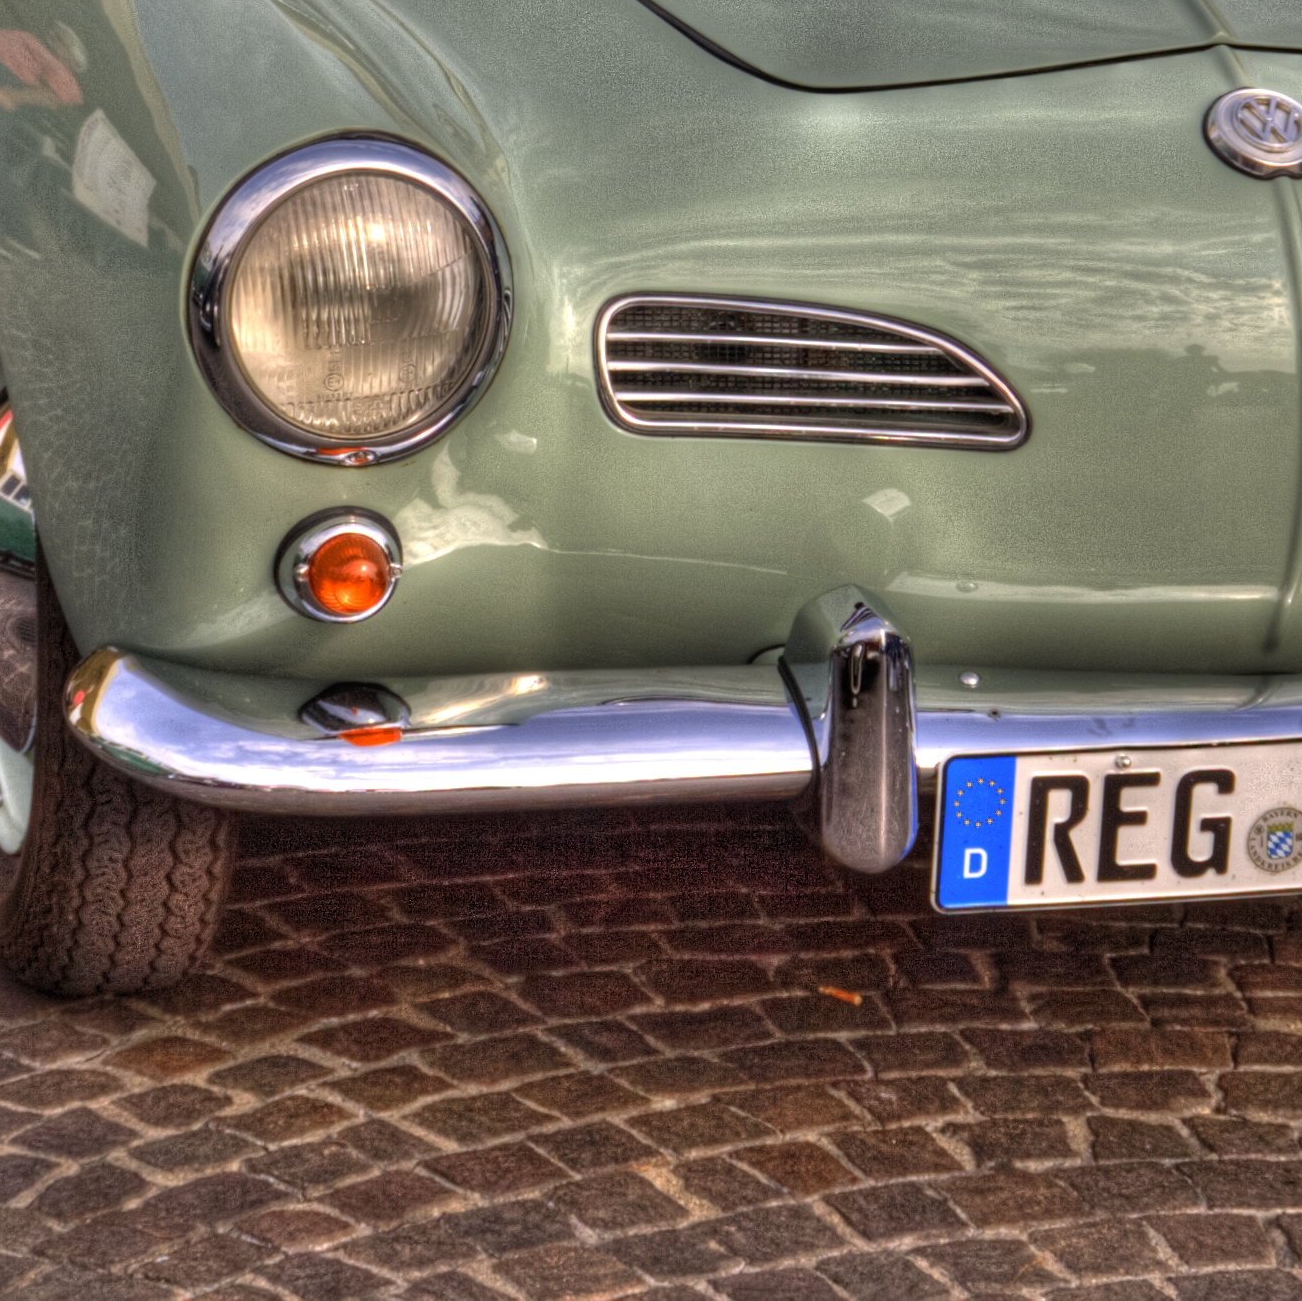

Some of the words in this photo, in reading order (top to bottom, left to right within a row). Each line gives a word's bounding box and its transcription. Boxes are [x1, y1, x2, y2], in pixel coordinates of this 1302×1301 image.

[1024, 768, 1236, 886] REG
[1261, 809, 1299, 823] BAYERN
[962, 847, 989, 880] D
